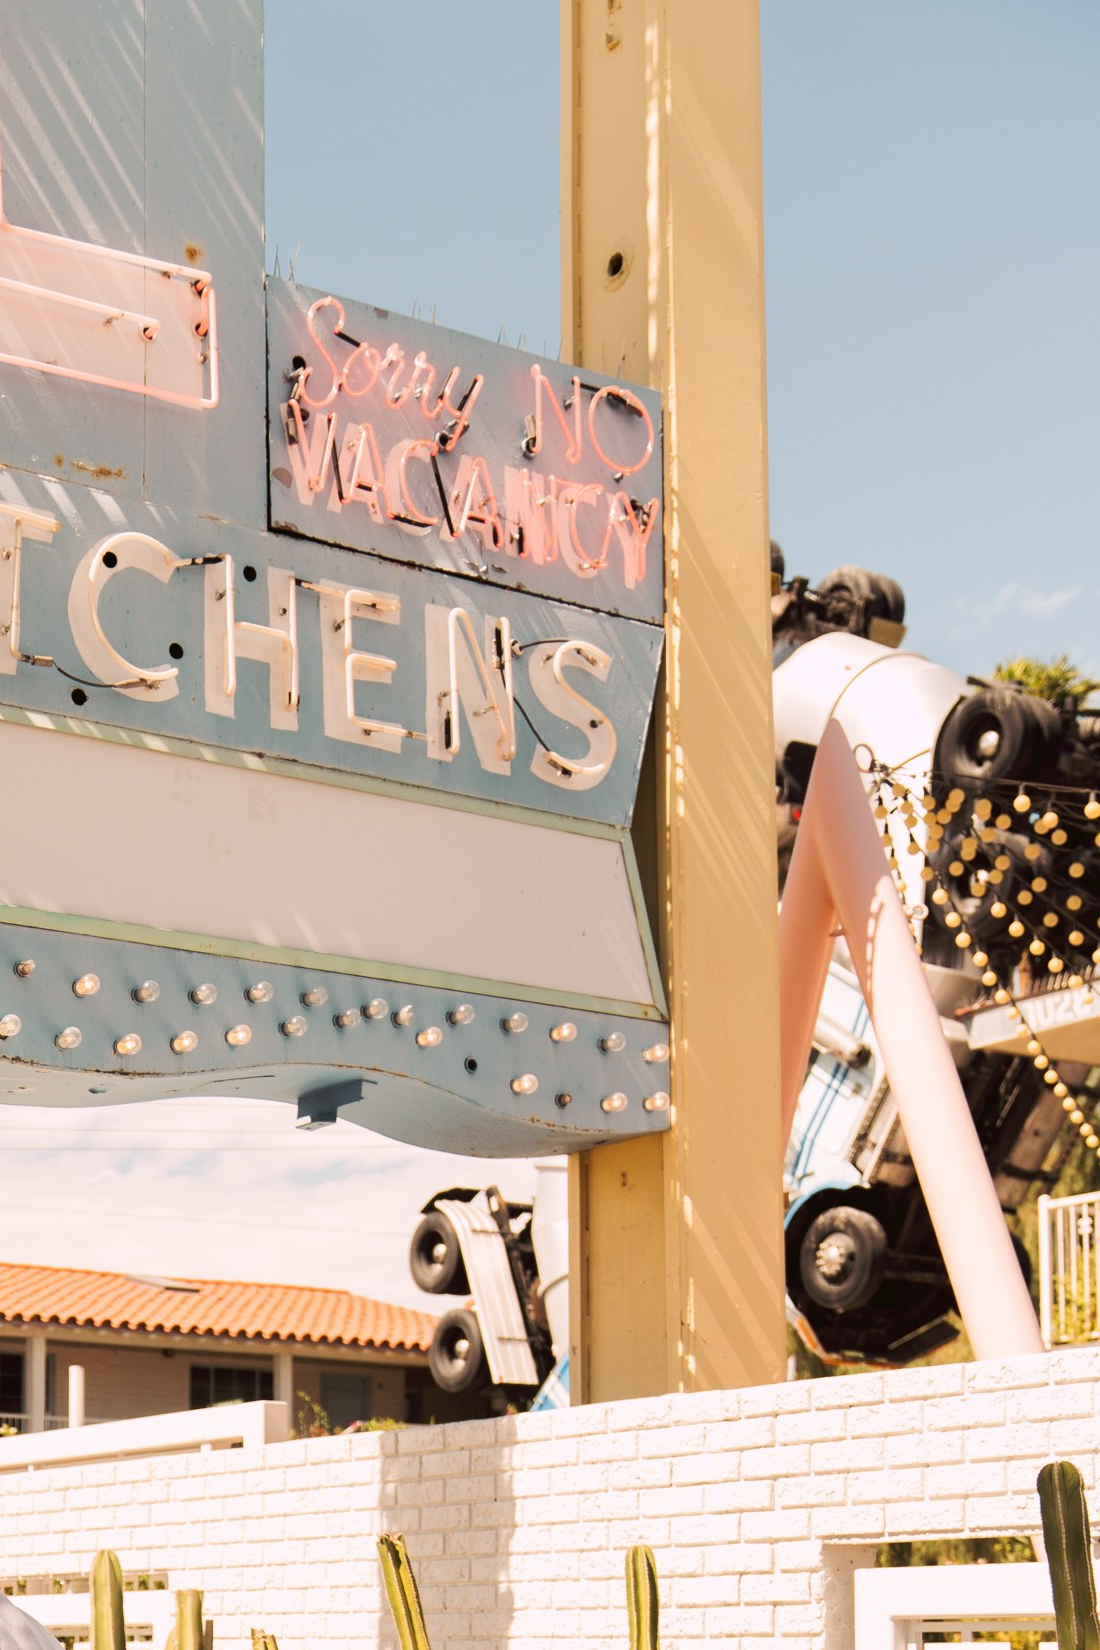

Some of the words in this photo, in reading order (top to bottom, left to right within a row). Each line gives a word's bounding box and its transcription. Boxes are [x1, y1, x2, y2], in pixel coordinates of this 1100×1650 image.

[298, 296, 485, 453] Sorry
[525, 363, 655, 477] NO
[278, 398, 661, 591] VACANCY
